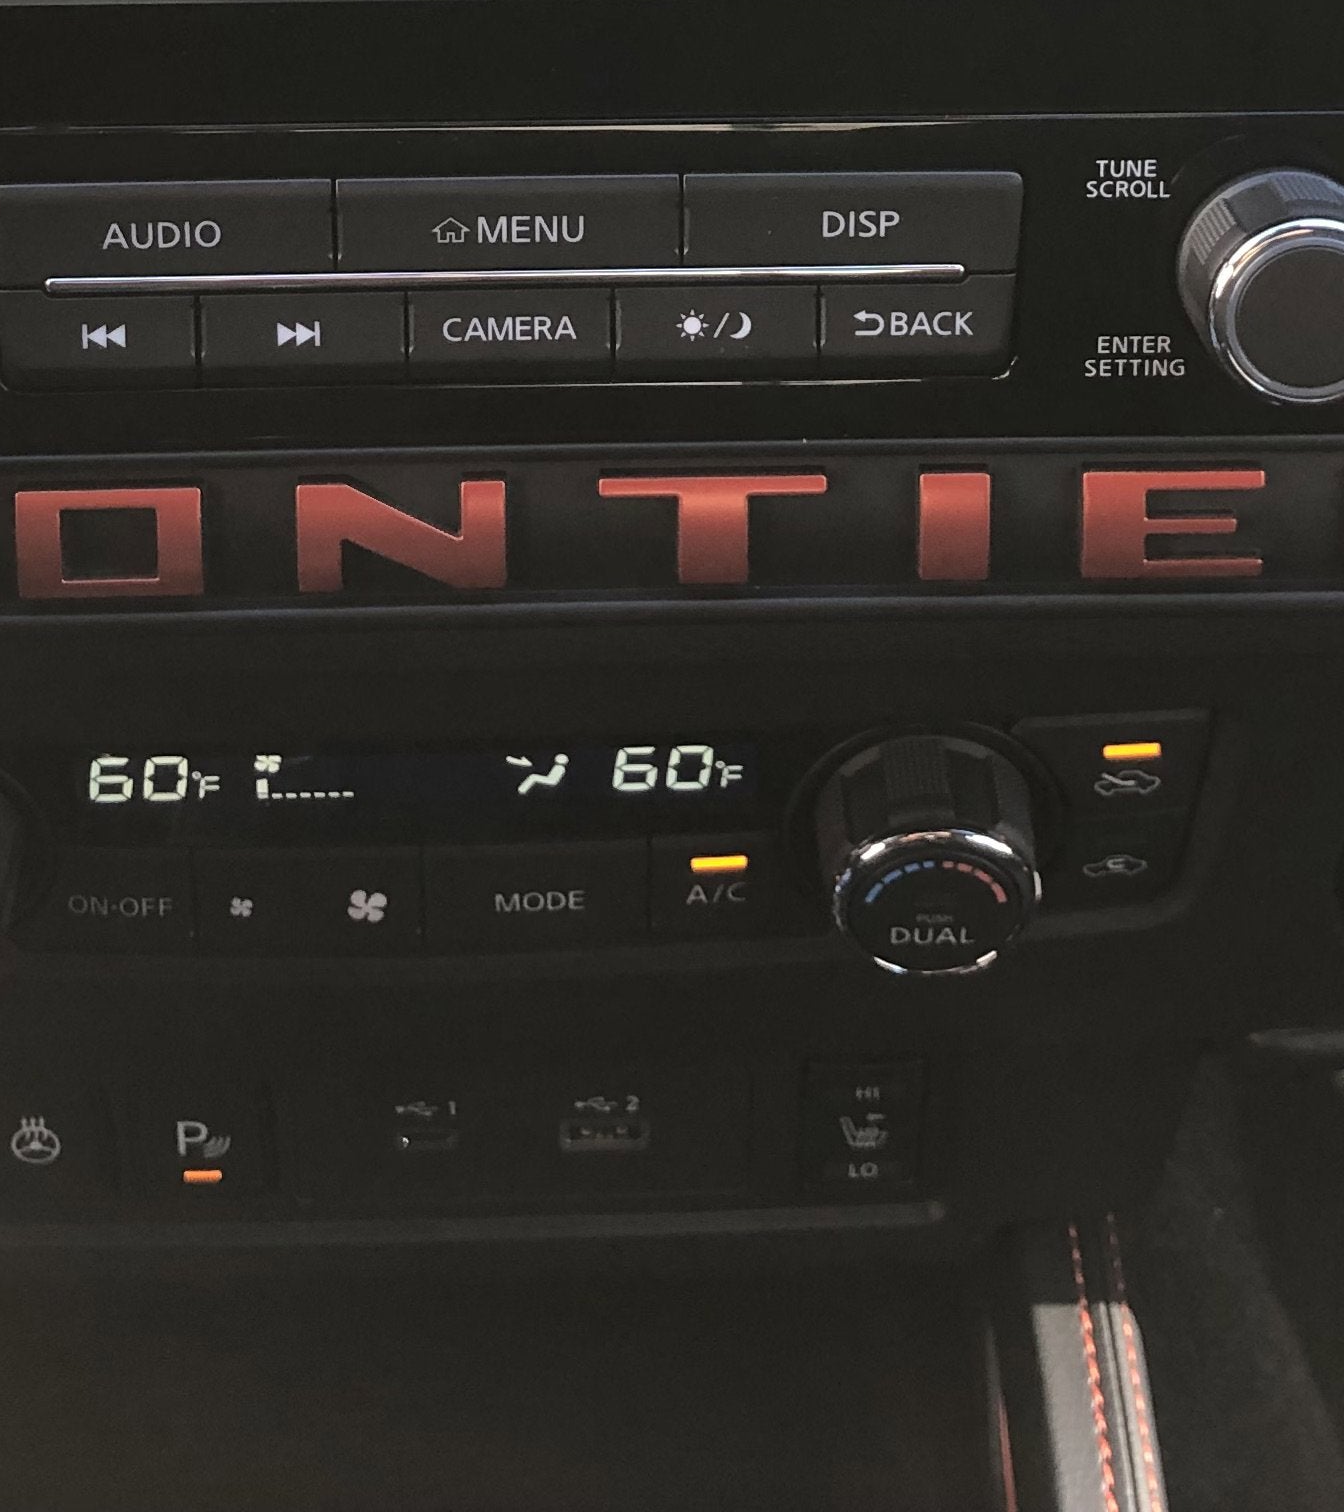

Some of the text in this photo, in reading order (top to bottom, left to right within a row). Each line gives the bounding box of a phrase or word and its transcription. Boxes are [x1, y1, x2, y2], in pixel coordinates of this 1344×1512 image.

[1095, 159, 1159, 178] TUNE
[1085, 178, 1171, 199] SCROLL
[101, 219, 222, 250] AUDIO
[476, 214, 587, 245] MENU
[819, 208, 900, 240] DISP
[441, 315, 577, 344] CAMERA
[888, 309, 974, 338] BACK
[1096, 335, 1172, 354] ENTER
[1084, 356, 1186, 377] SETTING
[493, 890, 586, 914] MODE
[686, 881, 748, 905] A/C
[889, 926, 976, 945] DUAL
[847, 1161, 879, 1179] LO
